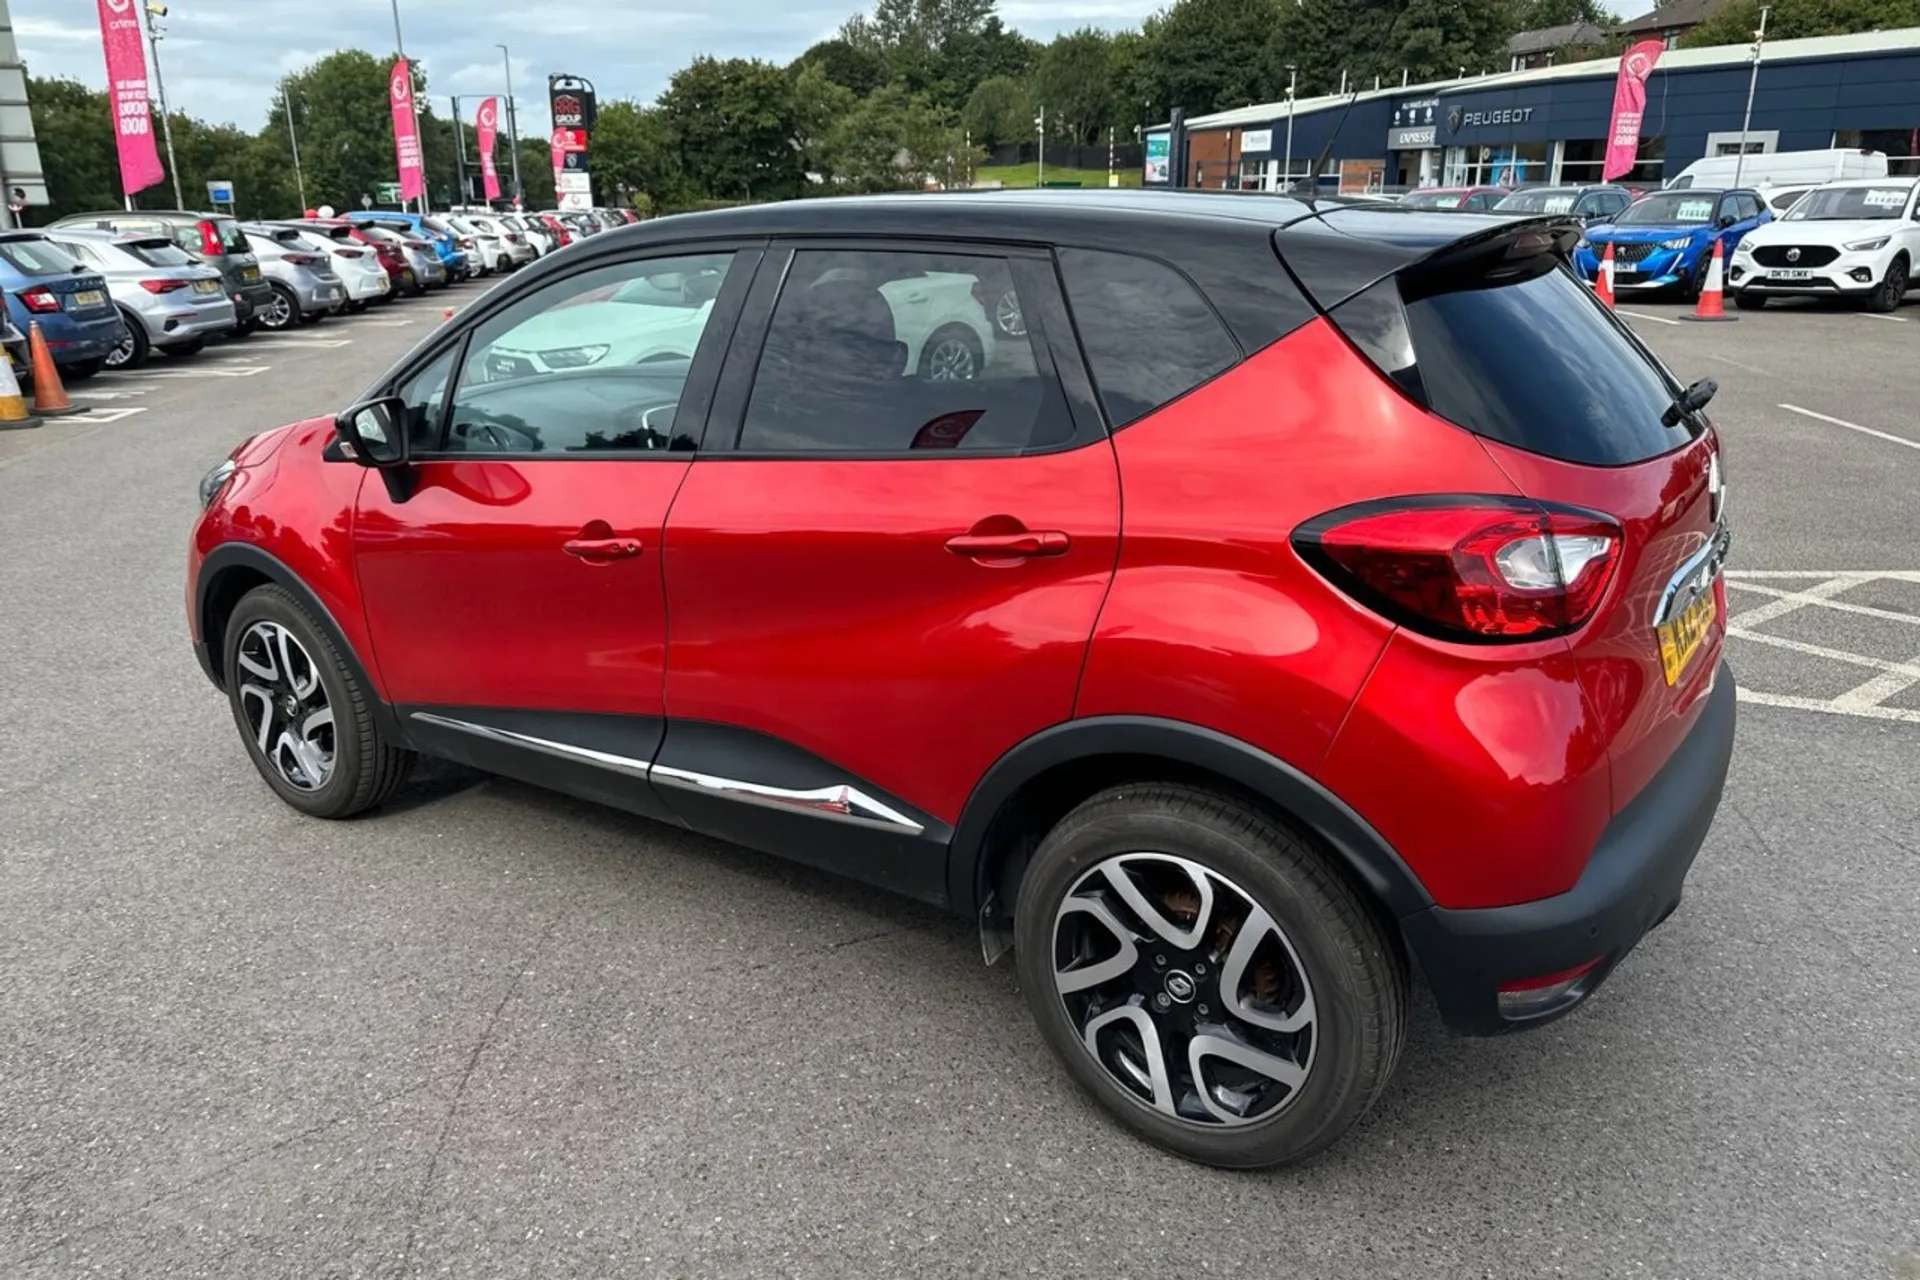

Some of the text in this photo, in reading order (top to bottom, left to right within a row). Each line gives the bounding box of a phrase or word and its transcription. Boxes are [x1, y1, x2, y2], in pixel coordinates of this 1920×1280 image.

[555, 97, 581, 113] RRG
[555, 113, 583, 123] GROUP
[1463, 107, 1533, 126] PEUGEOT
